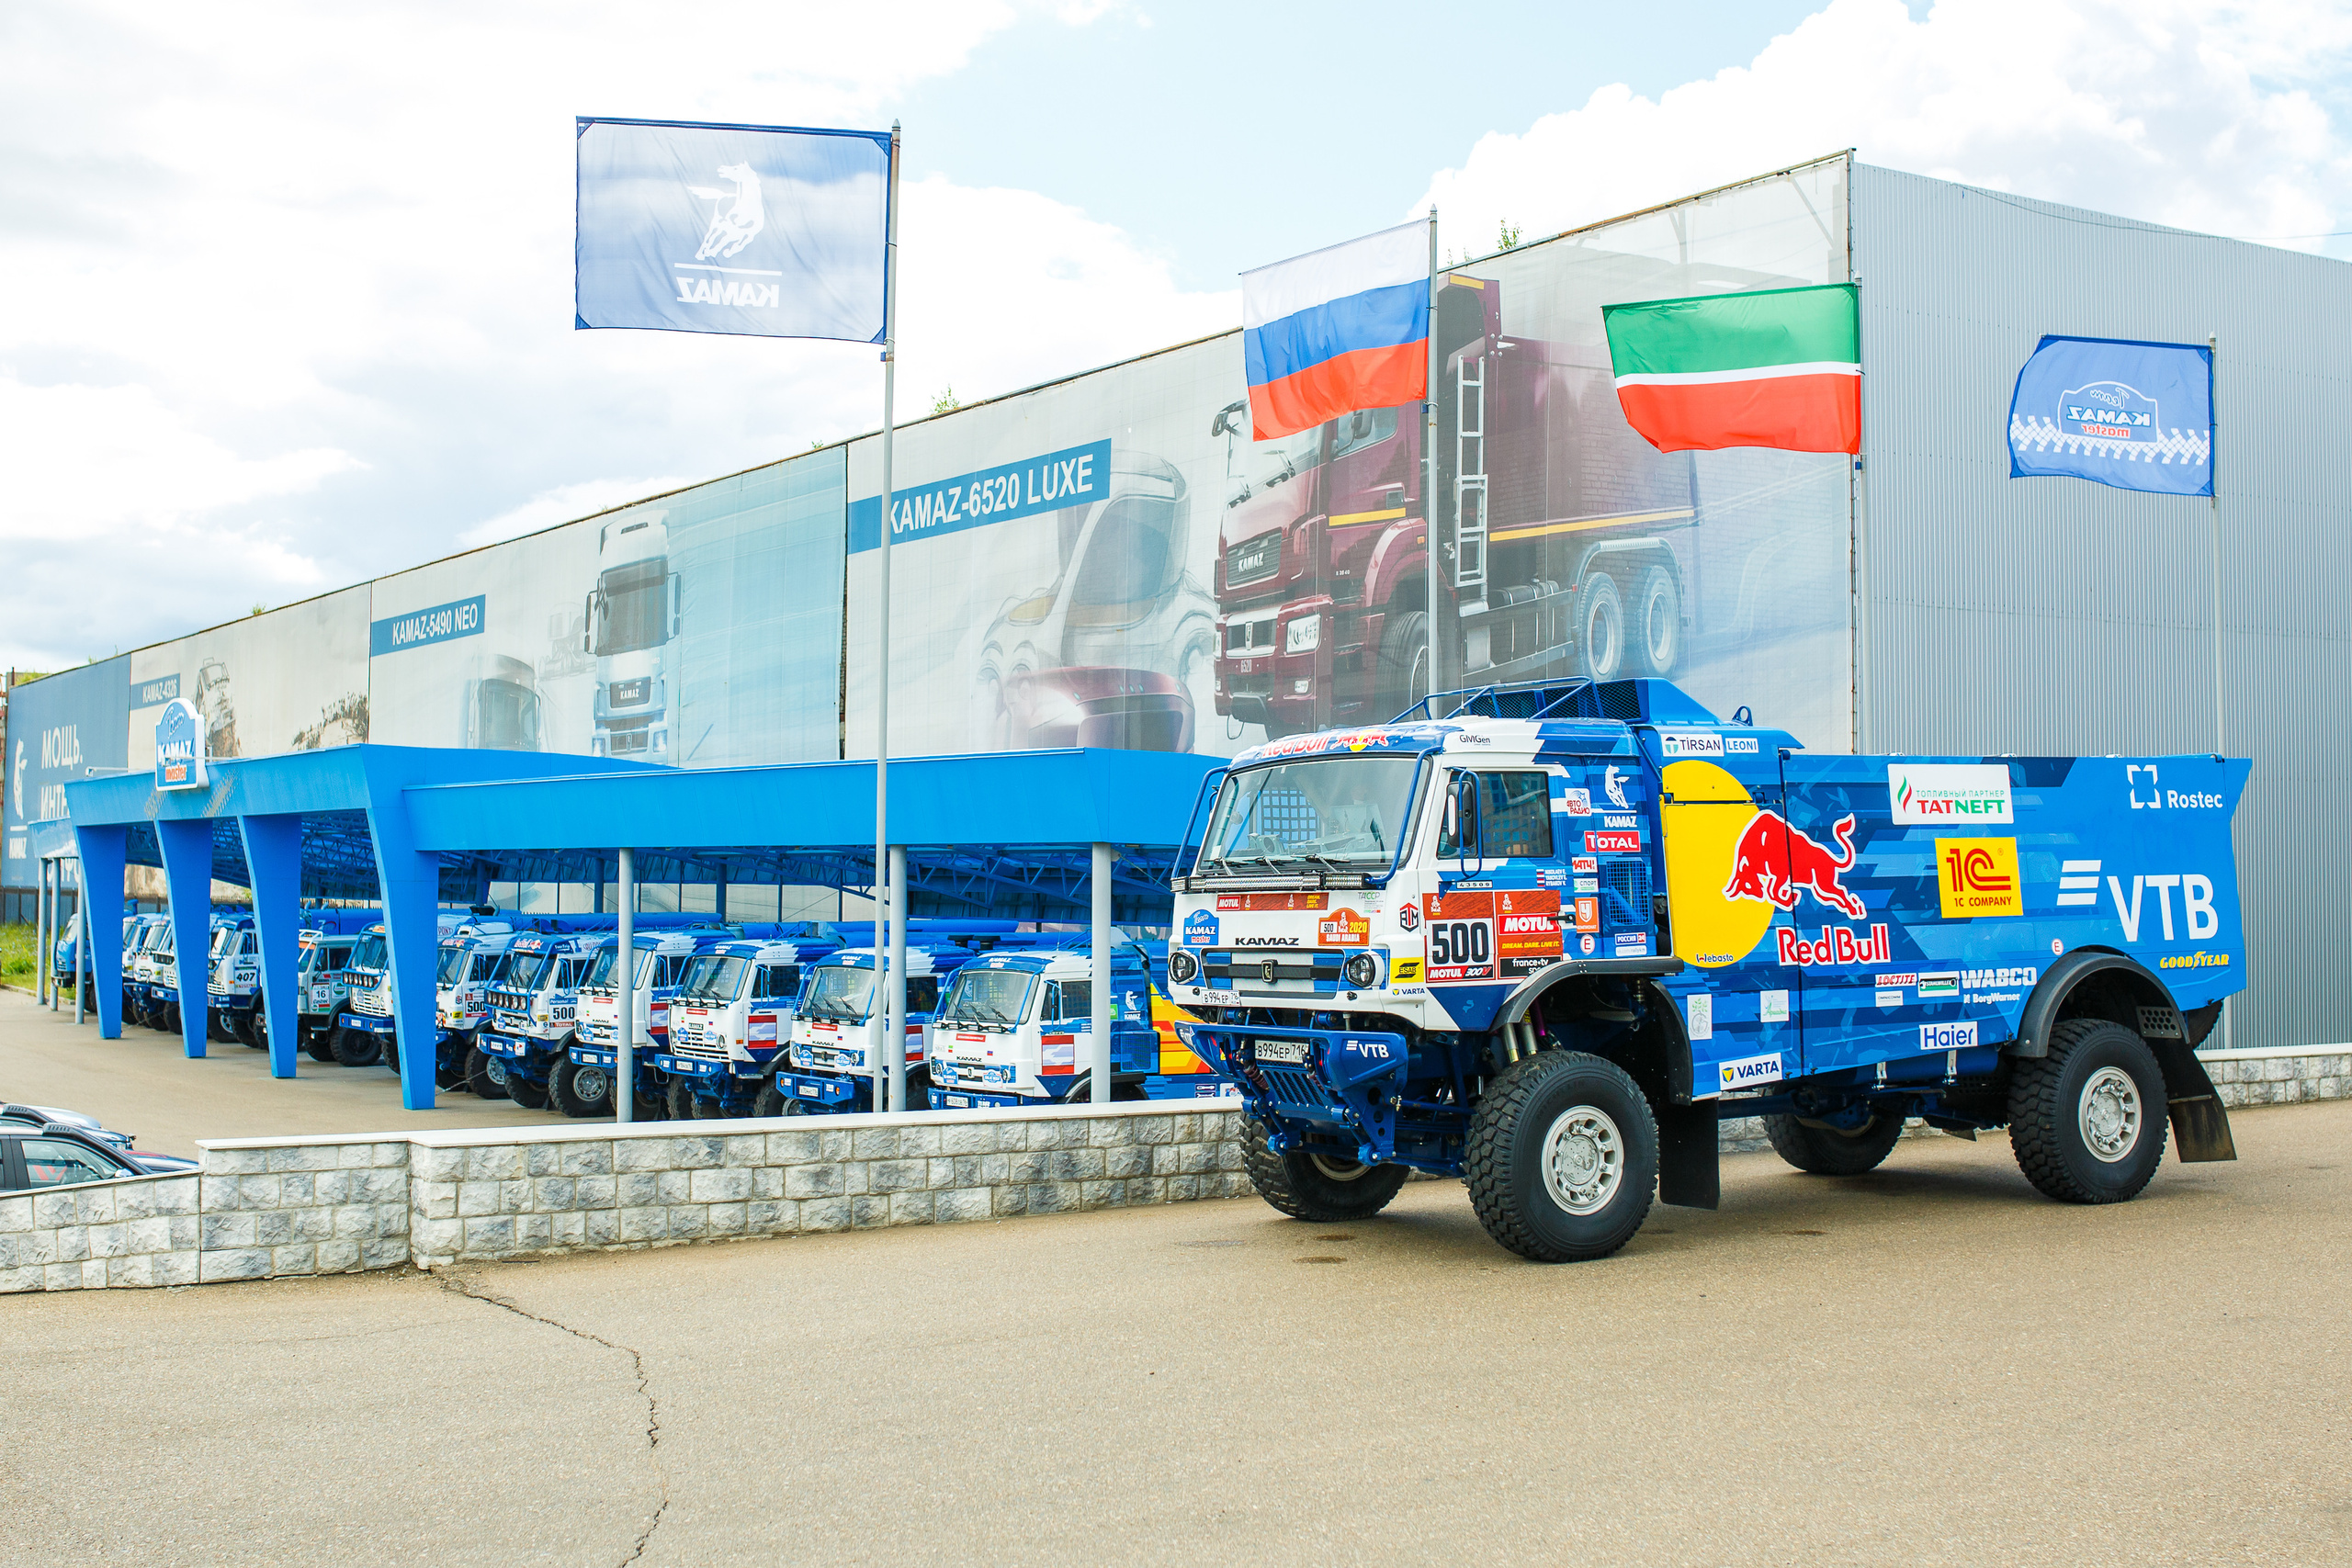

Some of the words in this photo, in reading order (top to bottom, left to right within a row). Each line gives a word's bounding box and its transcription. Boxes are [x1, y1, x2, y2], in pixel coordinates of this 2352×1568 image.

[890, 473, 1020, 534] KAMAZ-6520
[1027, 454, 1093, 504] LUXE
[1238, 552, 1264, 572] KAMAZ
[392, 609, 453, 646] KAMAZ-5490
[454, 603, 478, 631] NEO
[142, 679, 177, 703] KAMAZ-4326
[620, 688, 639, 699] KAMAZ
[41, 724, 84, 770] МОЩЬ.
[1726, 740, 1757, 750] LEONI
[157, 738, 196, 767] KAMAZ
[1917, 789, 1966, 798] ТОПЛИВНЫЙ
[1968, 789, 2005, 798] ПАРТНЕР
[2166, 790, 2223, 808] Rostec
[40, 782, 71, 819] ИНТЕ
[1917, 799, 2005, 814] TATNEFT
[1570, 807, 1590, 815] РАДИО
[1603, 815, 1638, 828] KAMAZ
[1218, 898, 1238, 908] MOTUL
[1968, 896, 2012, 907] COMPANY
[2107, 874, 2219, 942] VTB
[1185, 926, 1216, 935] KAMAZ
[1323, 923, 1334, 932] 500
[1349, 921, 1368, 933] 2020
[1504, 917, 1554, 932] MOTUL
[1191, 935, 1210, 943] master
[1235, 937, 1299, 946] KAMAZ
[1326, 933, 1340, 942] SAUDI
[1341, 933, 1360, 942] ARABIA
[1431, 921, 1488, 964] 500
[1584, 938, 1591, 950] E
[1777, 925, 1835, 966] Red
[1834, 923, 1891, 964] Bull
[236, 972, 256, 982] 407
[1430, 968, 1462, 979] MOTUL
[1464, 966, 1492, 976] 300V
[1961, 967, 2038, 988] WABCO
[1876, 975, 1916, 986] LOCTITE
[316, 989, 326, 999] 16
[1973, 993, 2020, 1004] BorgWarner
[467, 1001, 485, 1012] 500
[553, 1007, 575, 1020] 500
[1924, 1024, 1973, 1047] Haier
[1291, 1043, 1305, 1055] 716
[1359, 1043, 1389, 1058] VTB
[1736, 1060, 1780, 1077] VARTA
